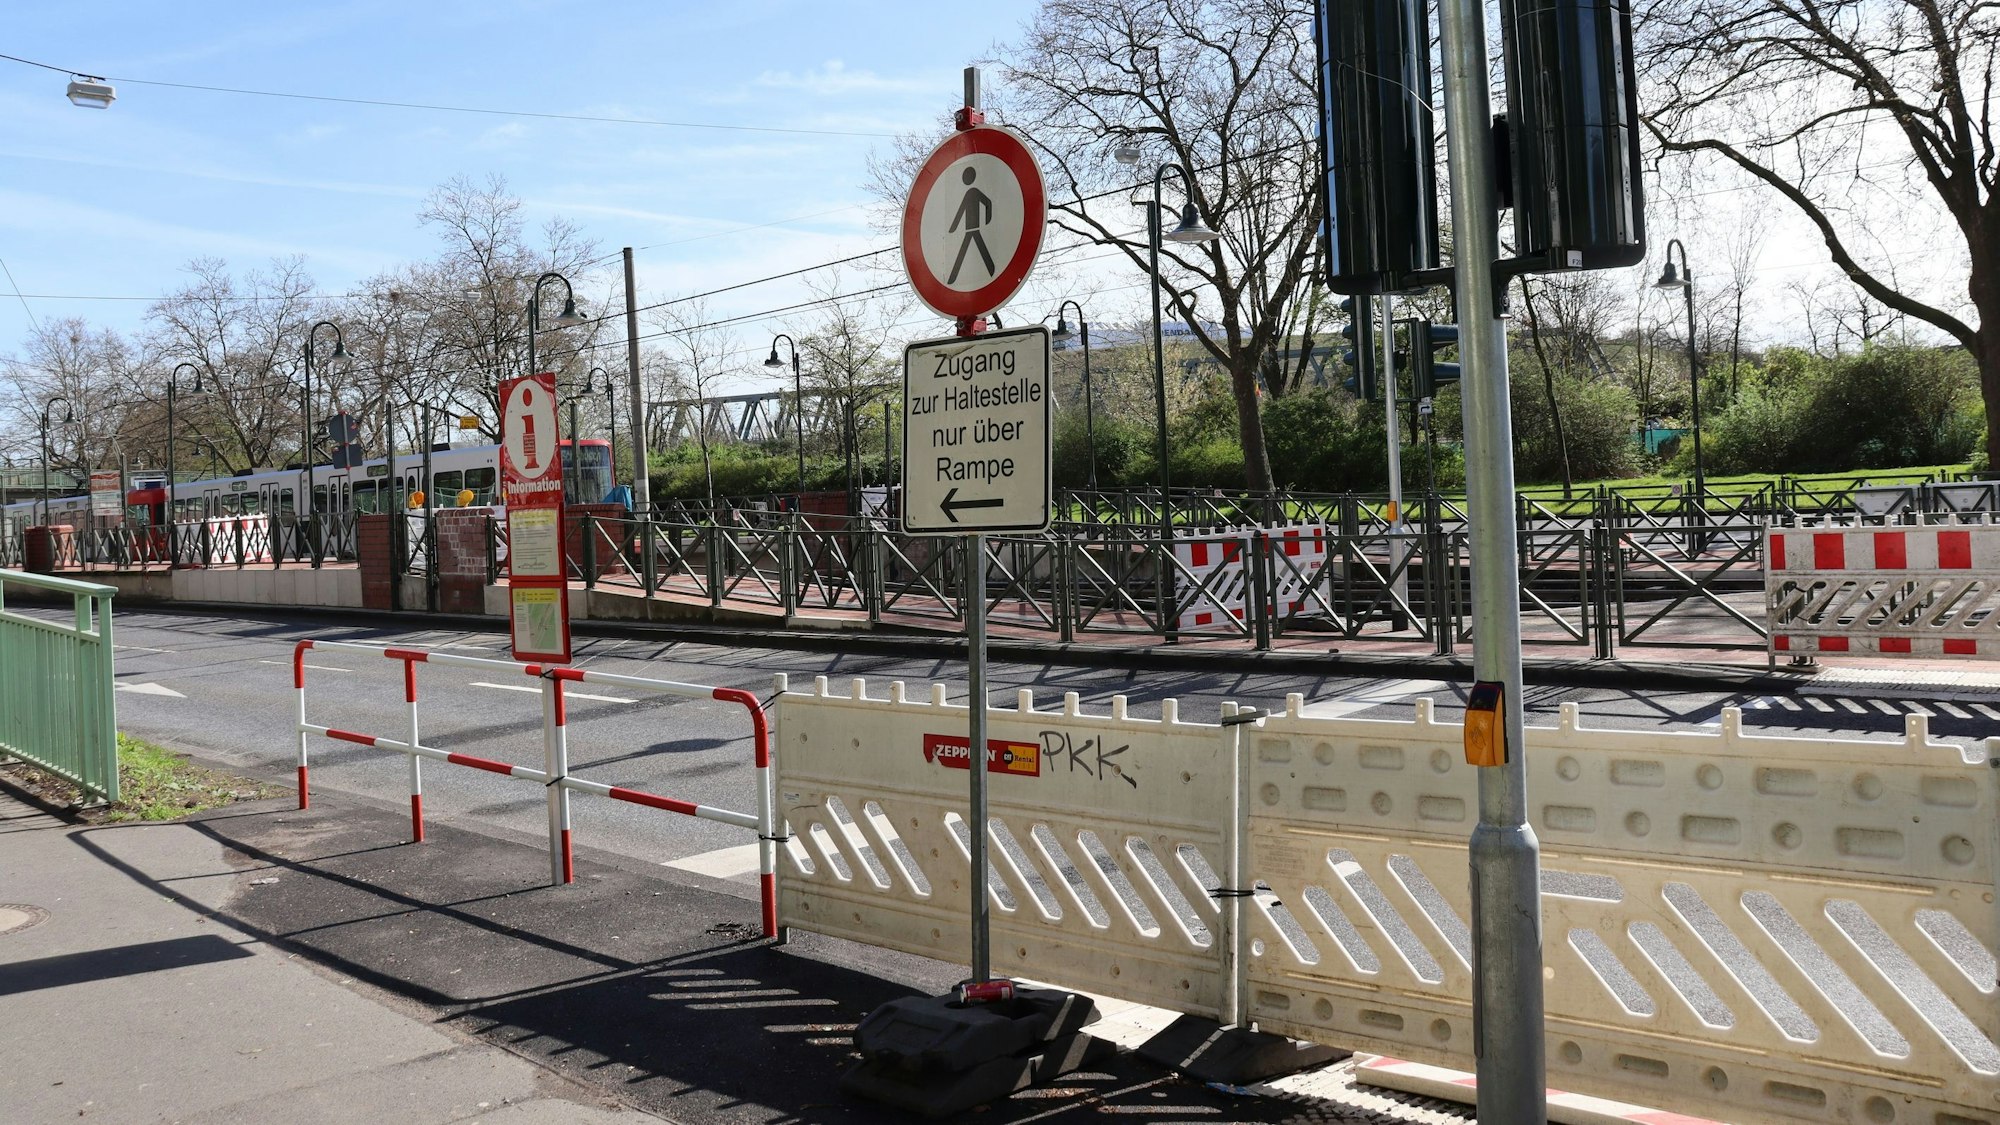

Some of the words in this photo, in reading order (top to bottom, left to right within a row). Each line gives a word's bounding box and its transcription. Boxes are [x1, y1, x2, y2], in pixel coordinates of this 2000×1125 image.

[933, 350, 1015, 381] Zugang
[911, 394, 939, 415] zur
[944, 377, 1041, 412] Haltestelle
[933, 426, 967, 448] nur
[974, 418, 1024, 444] über
[508, 478, 561, 494] Information
[937, 457, 1015, 485] Rampe
[1039, 731, 1137, 789] PKK
